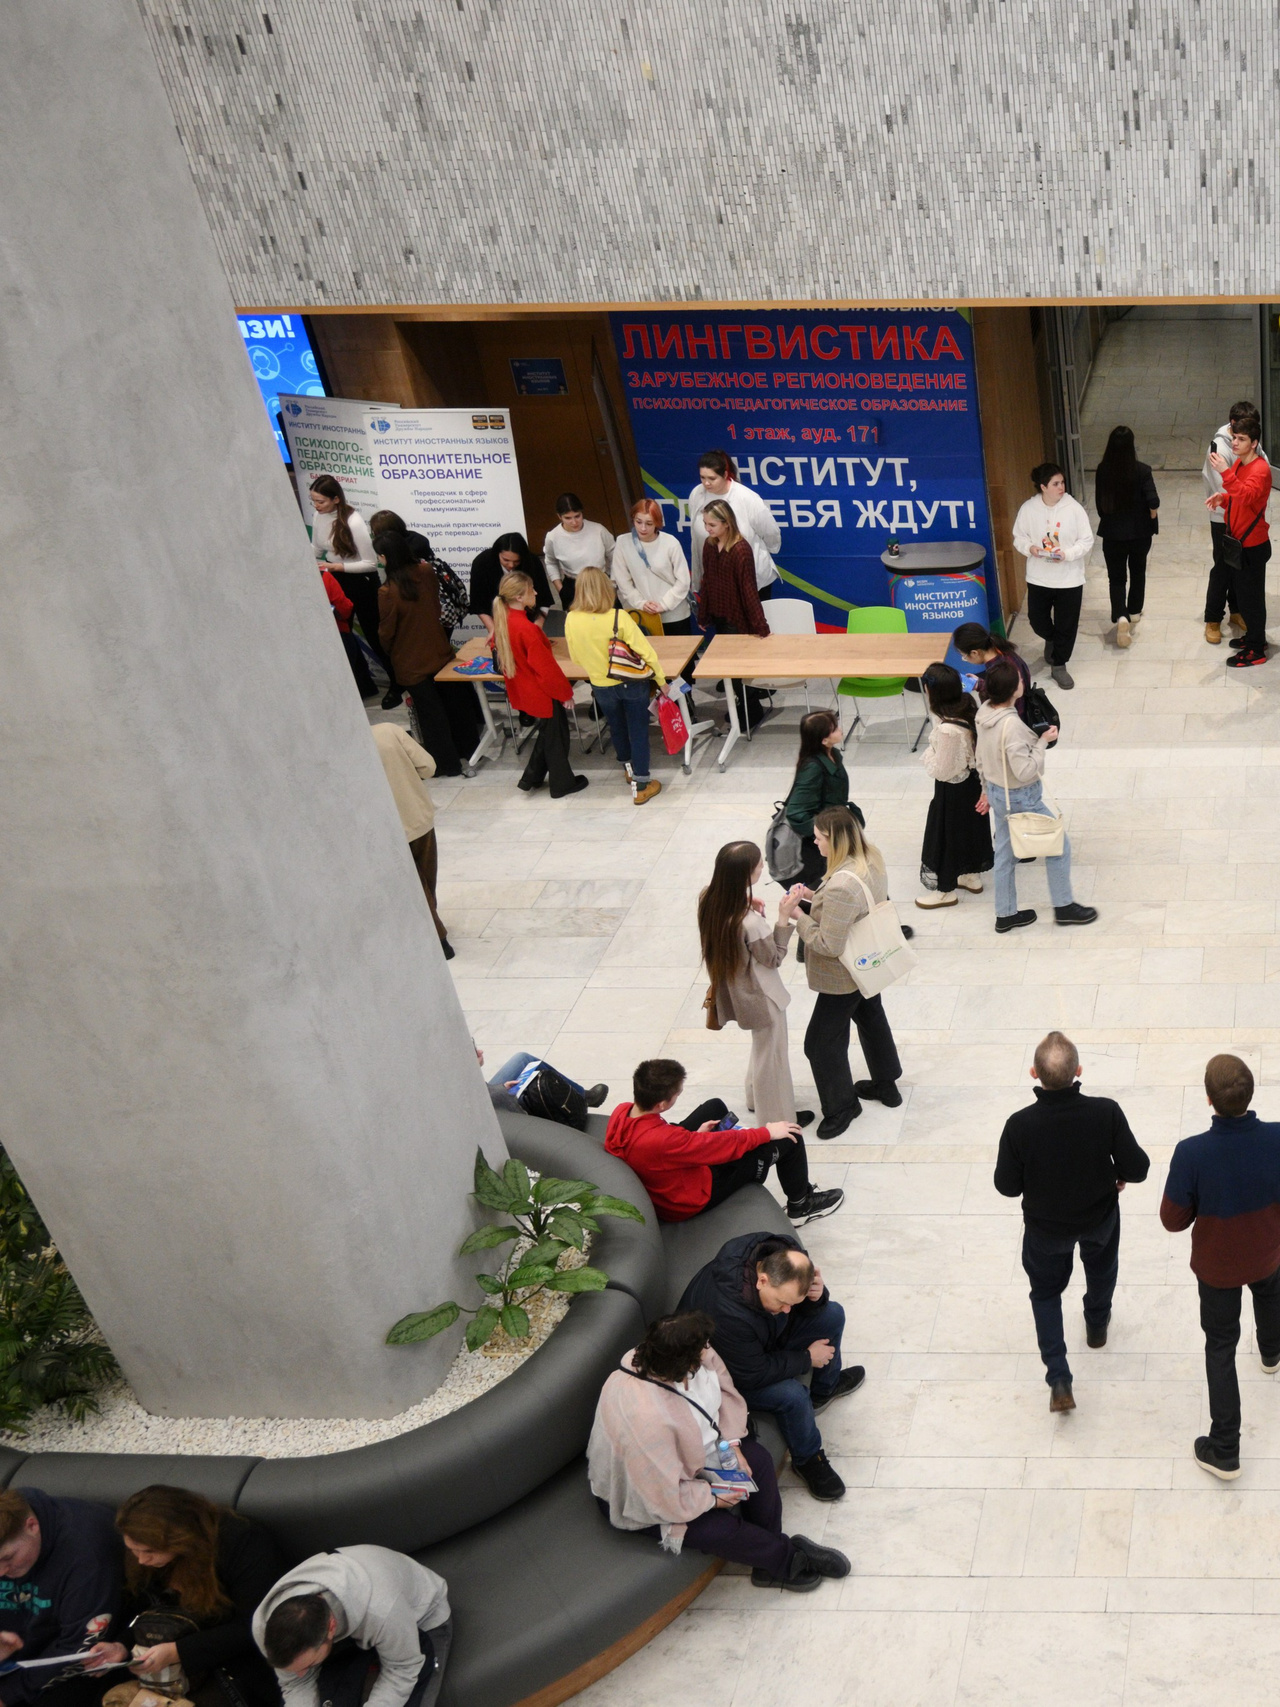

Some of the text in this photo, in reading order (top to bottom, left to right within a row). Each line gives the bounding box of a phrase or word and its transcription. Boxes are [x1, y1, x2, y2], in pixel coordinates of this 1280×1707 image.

[622, 324, 964, 360] ЛИНГВИСТИКА
[627, 371, 967, 391] ЗАРУБЕЖНОЕ РЕГИОНОВЕДЕНИЕ
[632, 398, 968, 412] ПСИХОЛОГО-ПЕДАГОГИЧЕСКОЕ ОБРАЗОВАНИЕ
[288, 421, 320, 430] ИНСТИТУТ
[727, 423, 879, 444] 1 этаж, ауд. 171
[294, 436, 363, 453] ПСИХОЛОГО-
[475, 437, 510, 445] ЯЗЫКОВ
[379, 453, 512, 466] ДОПОЛНИТЕЛЬНОЕ
[300, 460, 375, 478] ОБРАЗОВАНИЕ
[381, 468, 483, 480] ОБРАЗОВАНИЕ
[734, 456, 918, 492] НСТИТУТ,
[464, 489, 488, 497] сфере
[414, 497, 486, 505] профессиональной
[770, 499, 843, 528] ЕБЯ
[852, 500, 976, 534] ЖДУТ!
[452, 521, 502, 529] практический
[914, 590, 967, 601] ИНСТИТУТ
[904, 597, 979, 610] ИНОСТРАННЫХ
[922, 610, 964, 620] ЯЗЫКОВ
